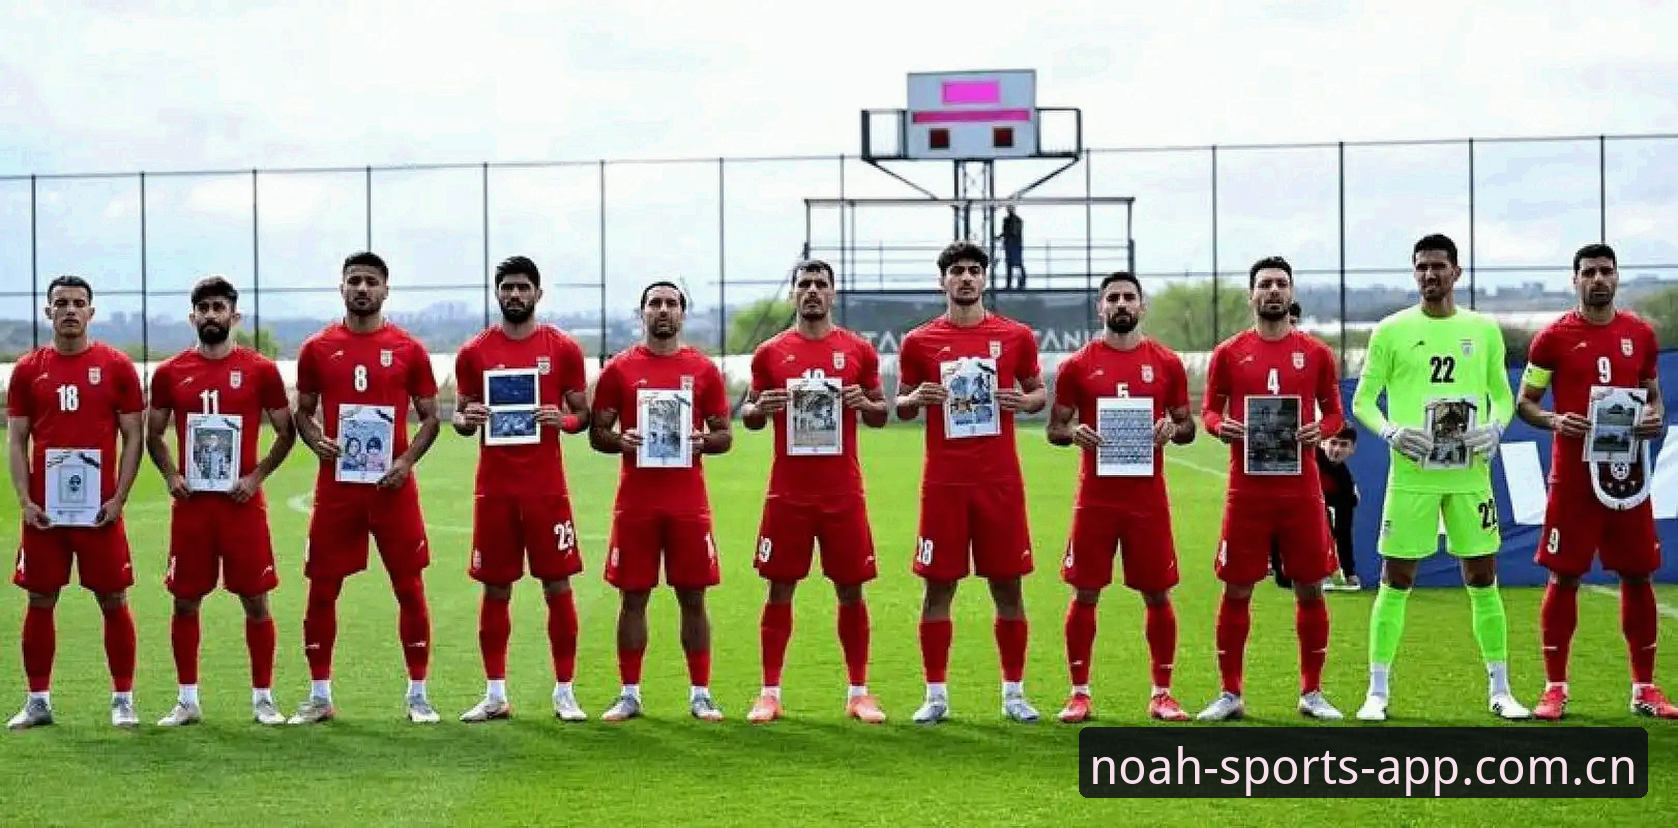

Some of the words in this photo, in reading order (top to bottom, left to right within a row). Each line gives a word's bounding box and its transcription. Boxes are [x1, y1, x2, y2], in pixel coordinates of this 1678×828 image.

[354, 365, 367, 392] 8
[1267, 368, 1280, 395] 4
[1430, 356, 1455, 383] 22
[1597, 356, 1611, 383] 9
[56, 385, 78, 411] 18
[198, 389, 218, 415] 11
[1547, 528, 1559, 554] 9
